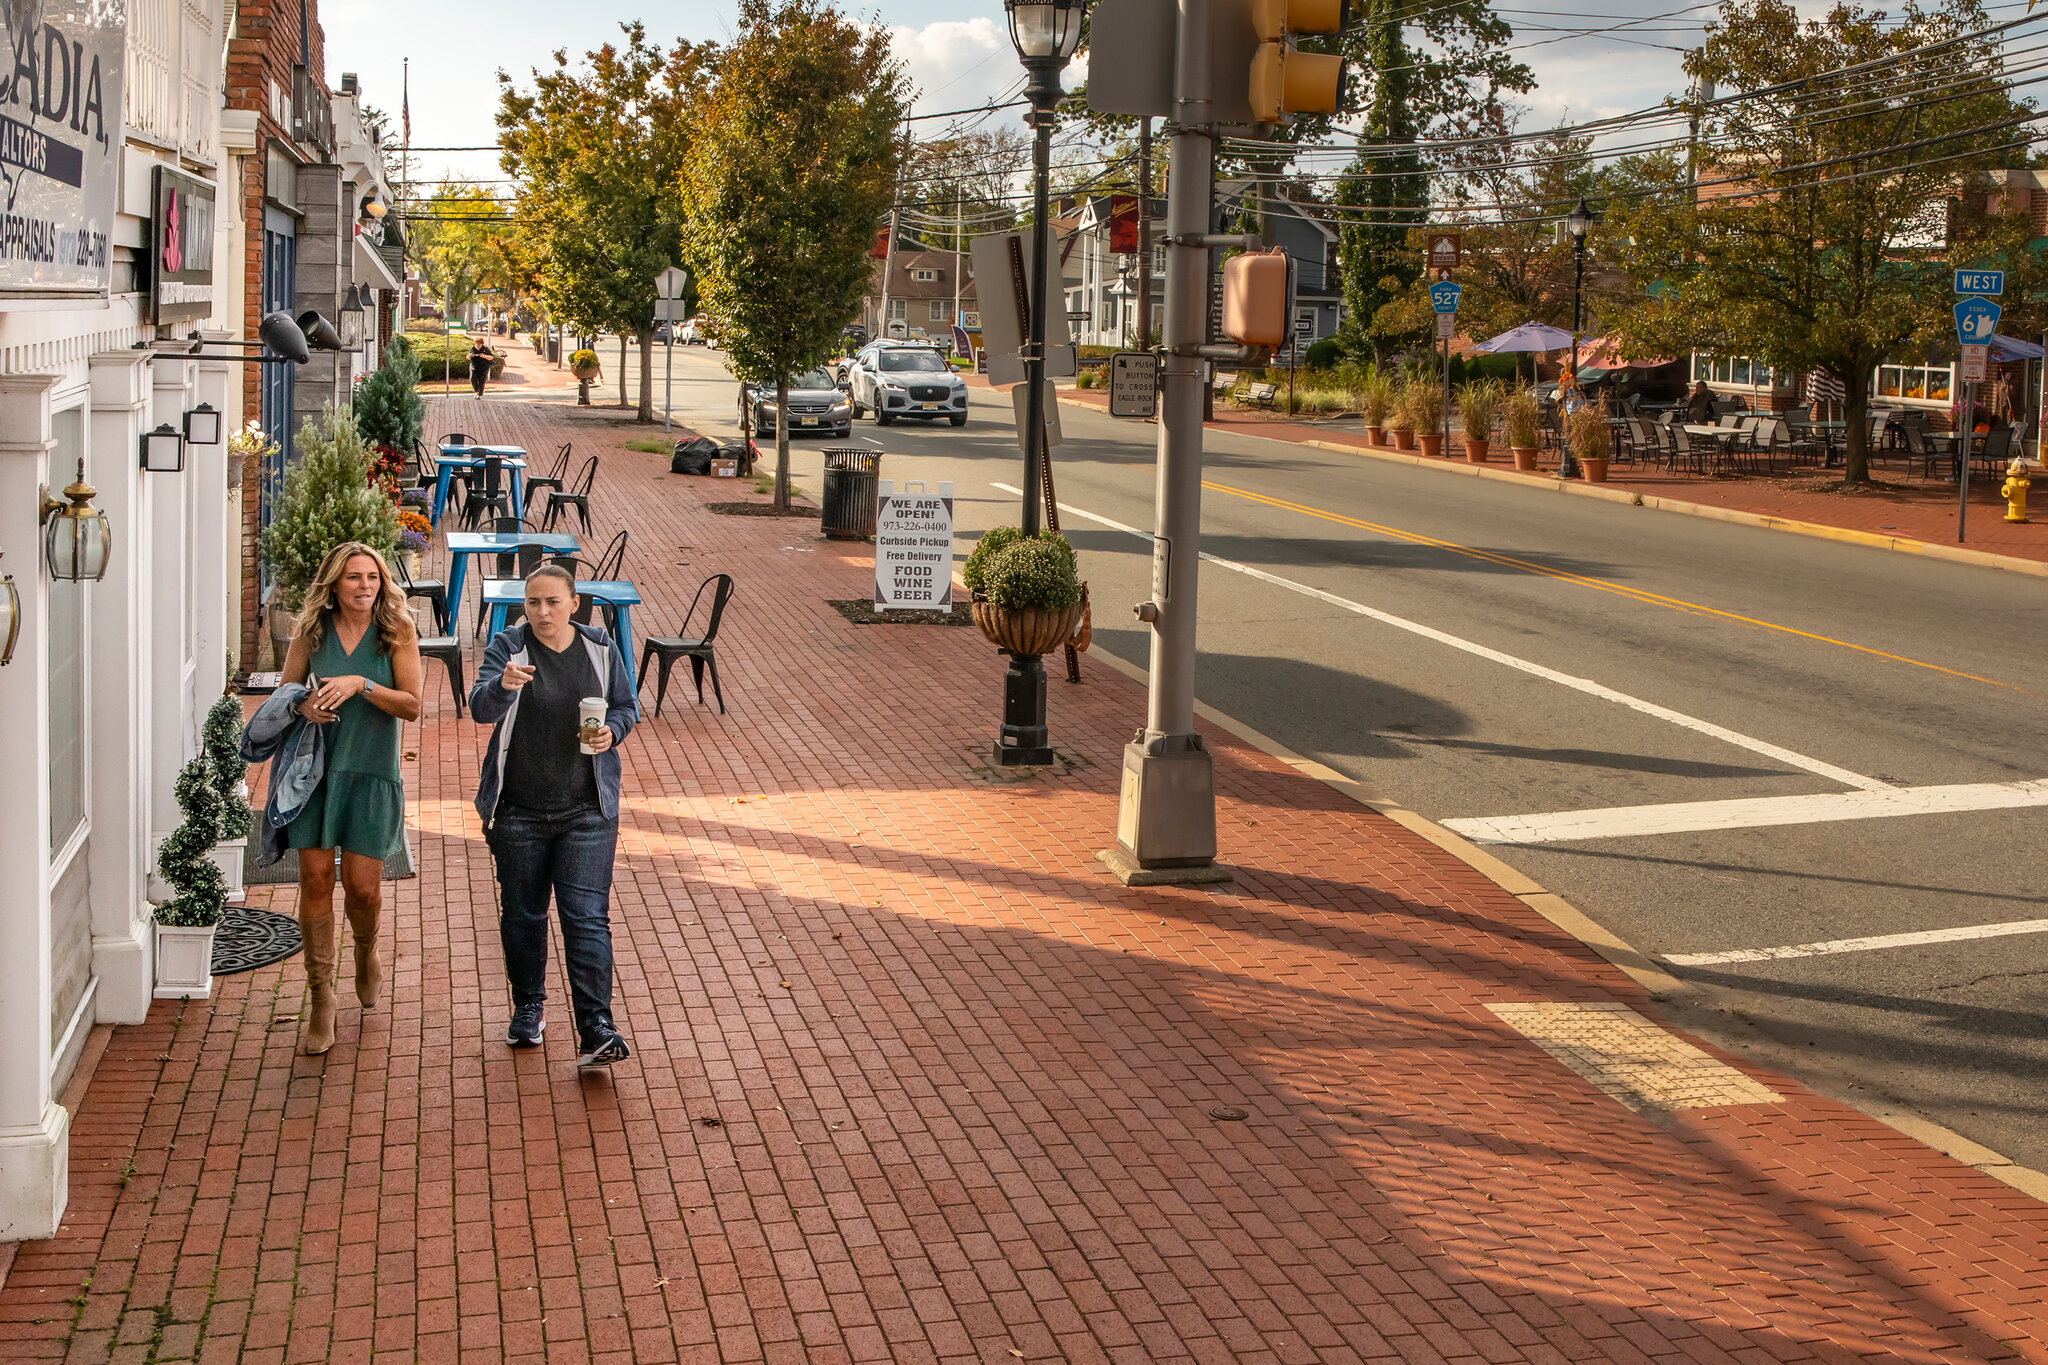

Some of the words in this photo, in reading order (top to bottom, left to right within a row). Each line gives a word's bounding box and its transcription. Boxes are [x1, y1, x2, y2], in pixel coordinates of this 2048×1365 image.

[1962, 275, 1997, 289] WEST
[1434, 292, 1460, 304] 527
[1970, 347, 1979, 355] NO
[891, 500, 911, 509] WE
[916, 500, 940, 509] ARE
[896, 510, 935, 519] OPEN!
[883, 521, 947, 531] 973-226-0400
[880, 536, 917, 546] Curbside
[920, 537, 949, 547] Pickup
[886, 551, 905, 560] Free
[907, 552, 942, 562] Delivery
[895, 566, 932, 576] FOOD
[893, 578, 932, 588] WINE
[893, 591, 932, 600] BEER
